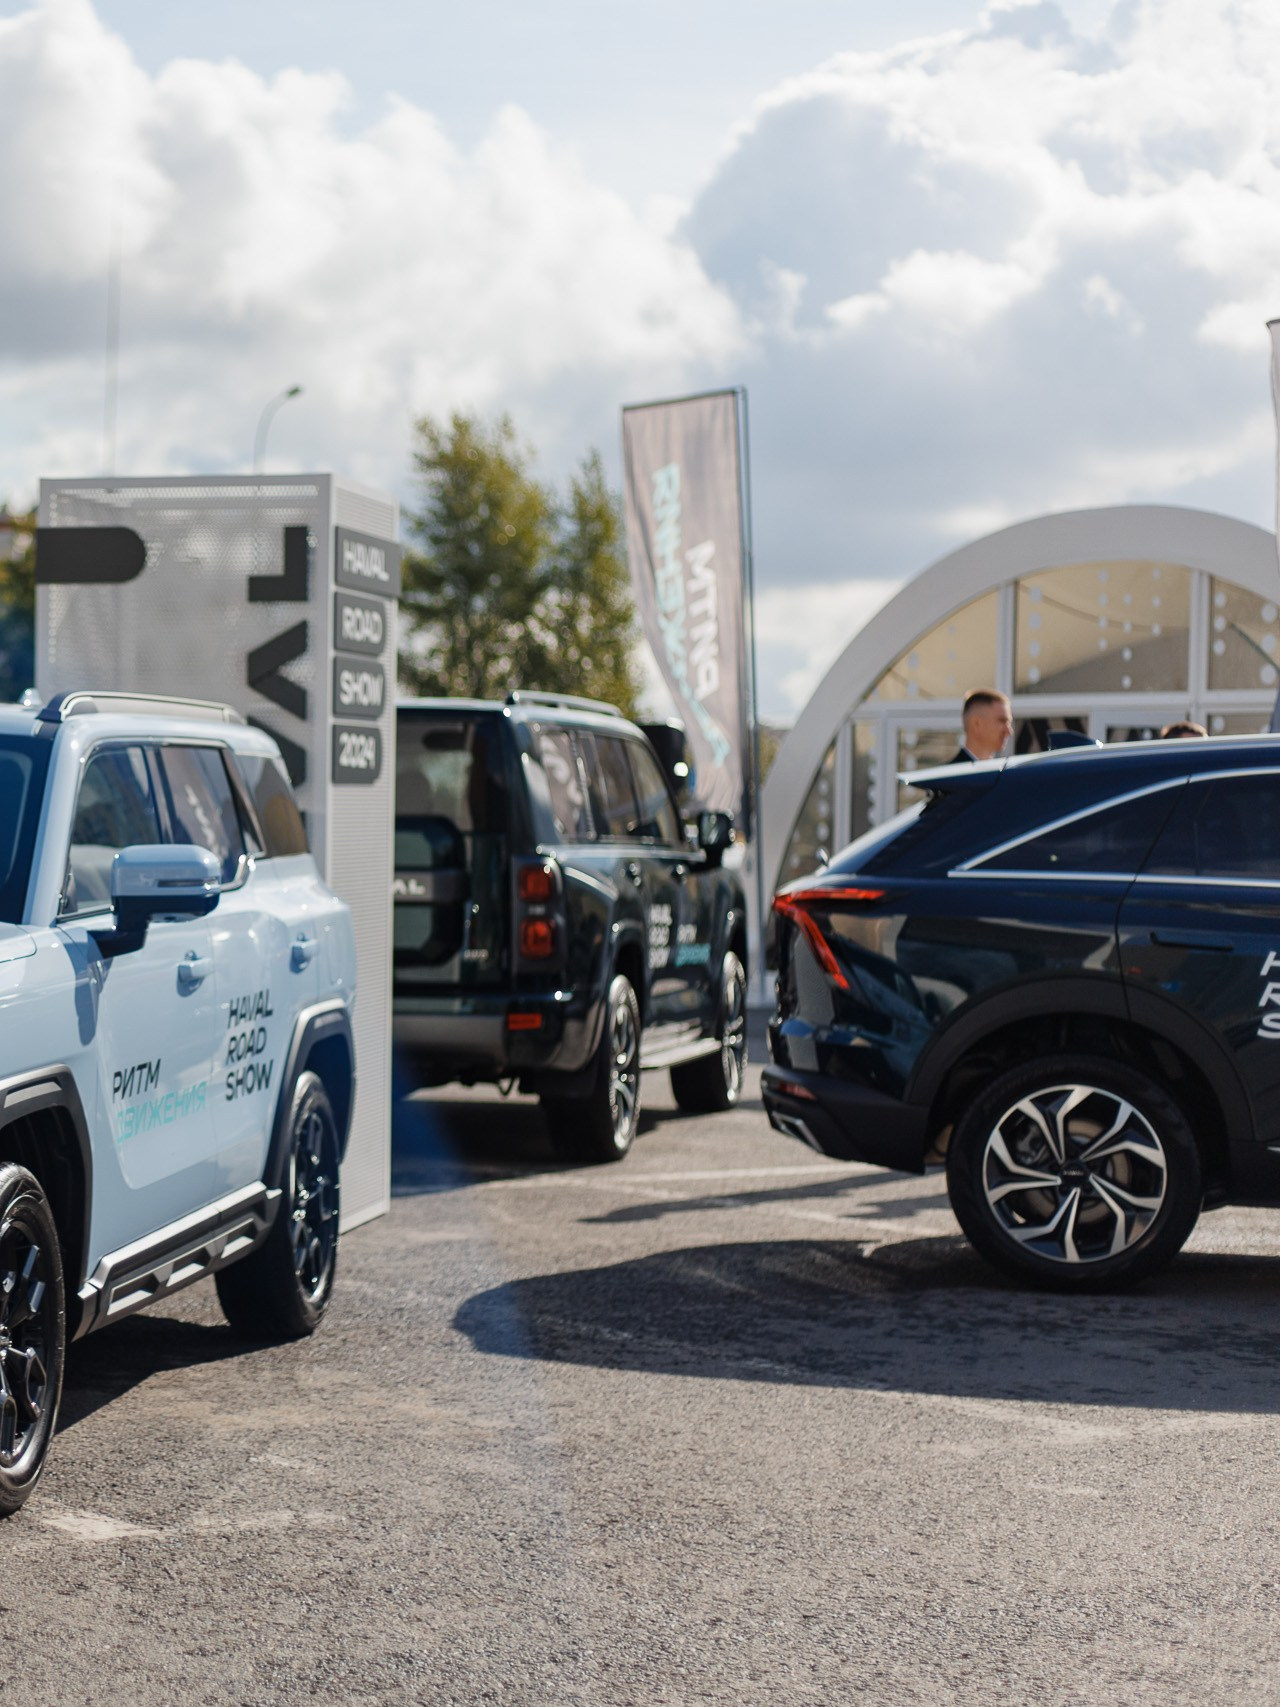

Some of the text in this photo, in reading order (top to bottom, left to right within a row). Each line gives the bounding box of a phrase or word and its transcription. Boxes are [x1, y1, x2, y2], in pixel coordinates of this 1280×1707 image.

[342, 538, 390, 582] HAVAL
[341, 605, 383, 645] ROAD
[247, 525, 307, 792] VAL
[339, 669, 384, 707] SHOW
[338, 731, 377, 770] 2024
[227, 988, 274, 1030] HAVAL
[224, 1026, 268, 1066] ROAD
[112, 1058, 162, 1104] РИТМ
[224, 1059, 274, 1101] SHOW
